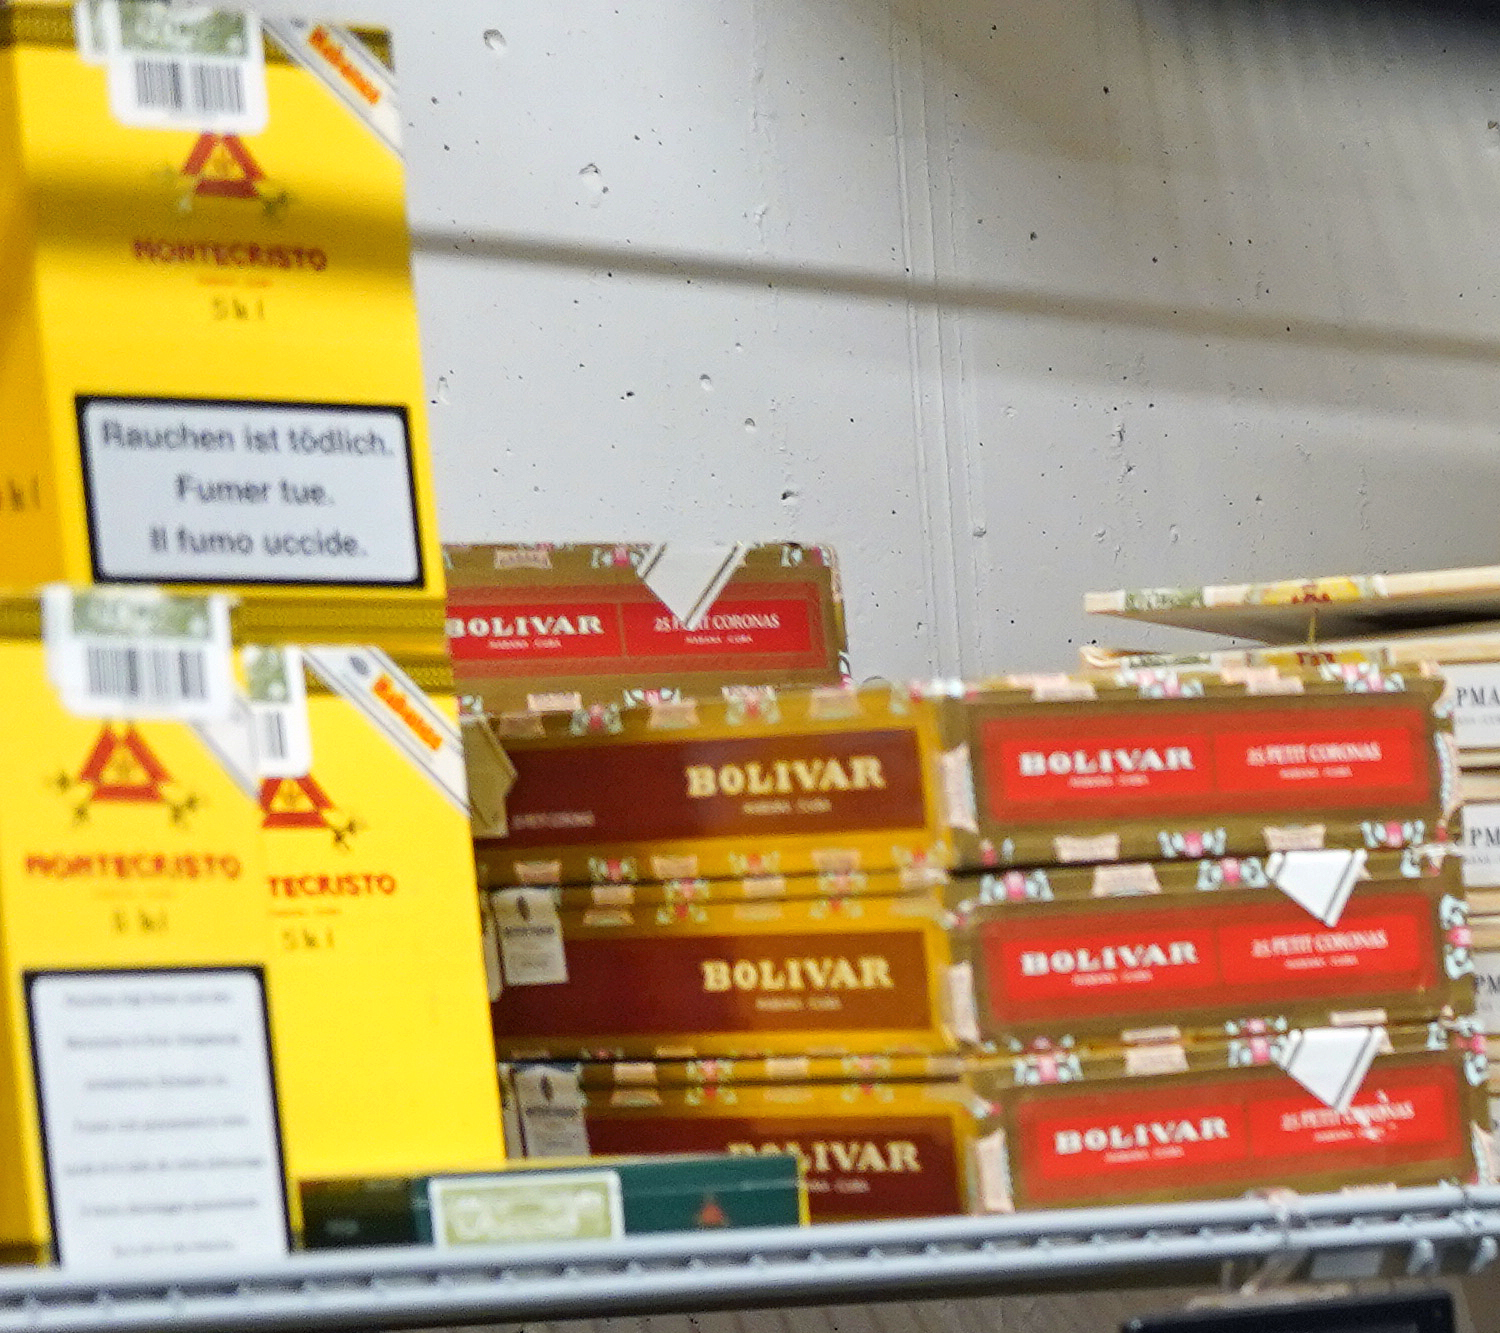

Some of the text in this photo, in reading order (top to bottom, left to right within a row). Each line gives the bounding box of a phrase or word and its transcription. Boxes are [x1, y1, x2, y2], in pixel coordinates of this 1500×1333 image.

[103, 423, 394, 457] Rauchen ist tödlich.
[176, 476, 333, 506] Fumer tue.
[176, 529, 255, 555] fumo
[262, 531, 367, 559] uccide.
[686, 756, 885, 797] BOLIVAR
[1019, 745, 1194, 778] BOLIVAR
[25, 855, 242, 880] MONTECRISTO
[702, 957, 893, 992] BOLIVAR
[1021, 940, 1198, 975] BOLIVAR
[1055, 1117, 1229, 1154] BOLIVAR
